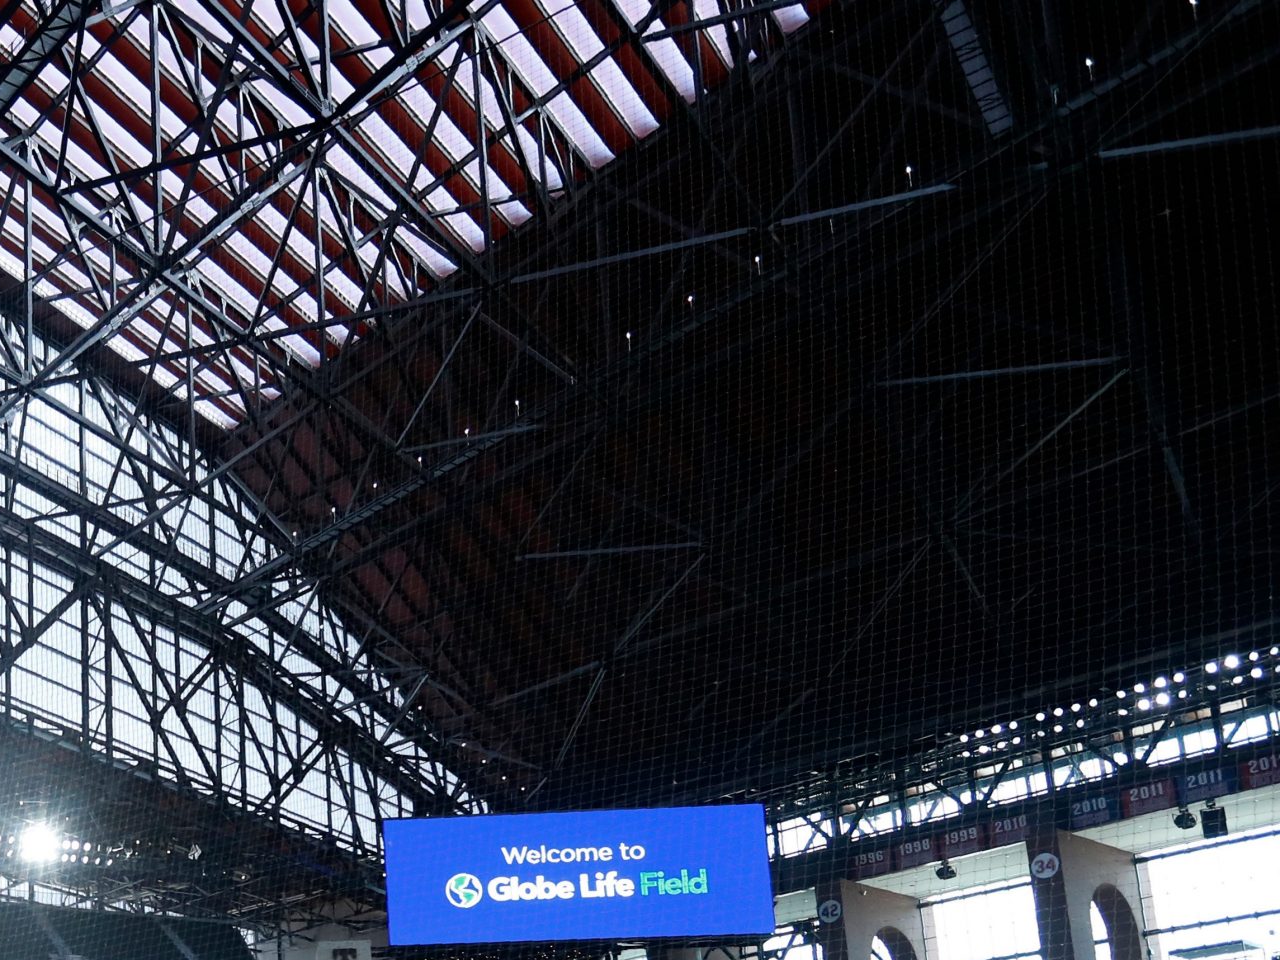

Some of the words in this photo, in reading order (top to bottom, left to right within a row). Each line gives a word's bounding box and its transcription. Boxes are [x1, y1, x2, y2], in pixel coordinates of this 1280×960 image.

[1248, 754, 1280, 773] 201
[1186, 768, 1223, 788] 2011
[1130, 782, 1164, 801] 2011
[1073, 797, 1107, 815] 2010
[994, 815, 1027, 833] 2010
[945, 826, 977, 845] 1999
[501, 845, 612, 864] Welcome
[619, 842, 645, 860] to
[899, 838, 931, 856] 1998
[855, 851, 884, 866] 1996
[1034, 858, 1055, 874] 34
[487, 875, 575, 901] Globe
[580, 871, 635, 898] Life
[639, 868, 708, 896] Field
[821, 904, 839, 918] 42
